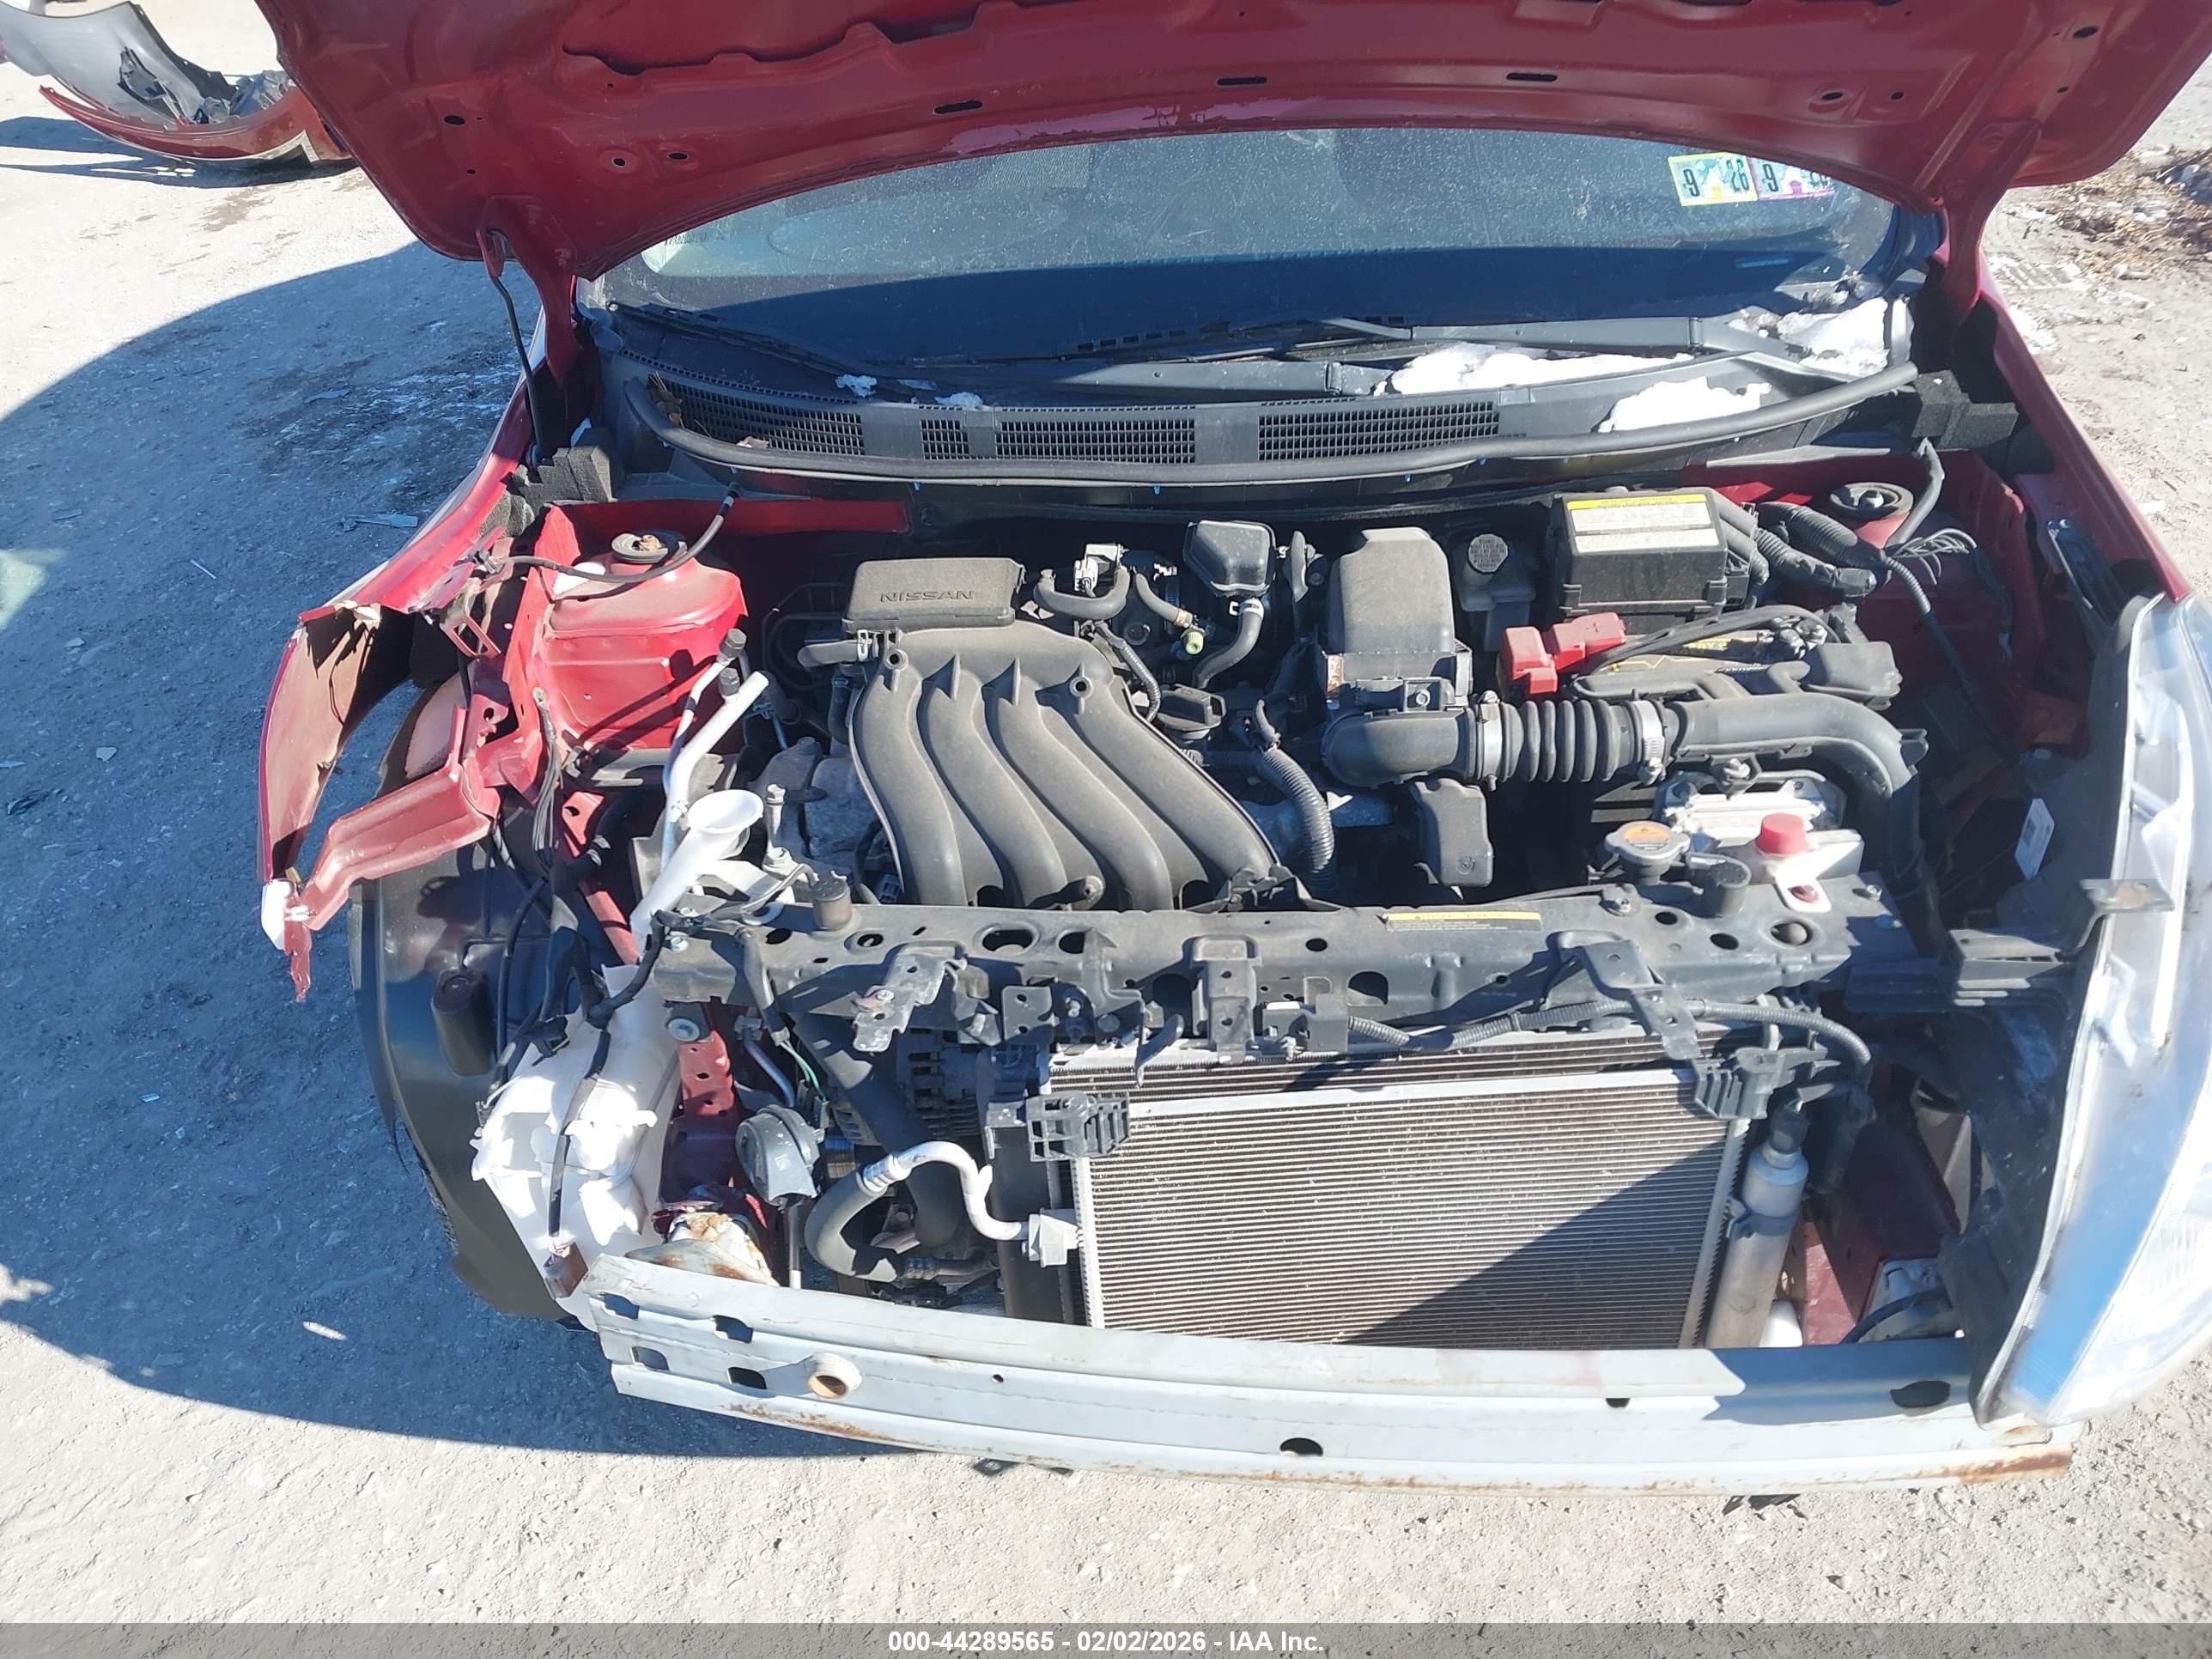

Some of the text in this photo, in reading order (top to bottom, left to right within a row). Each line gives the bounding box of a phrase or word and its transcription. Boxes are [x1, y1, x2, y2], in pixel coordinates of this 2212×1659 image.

[1683, 168, 1700, 198] 9
[1762, 163, 1779, 192] 9
[879, 590, 975, 603] NISSAN
